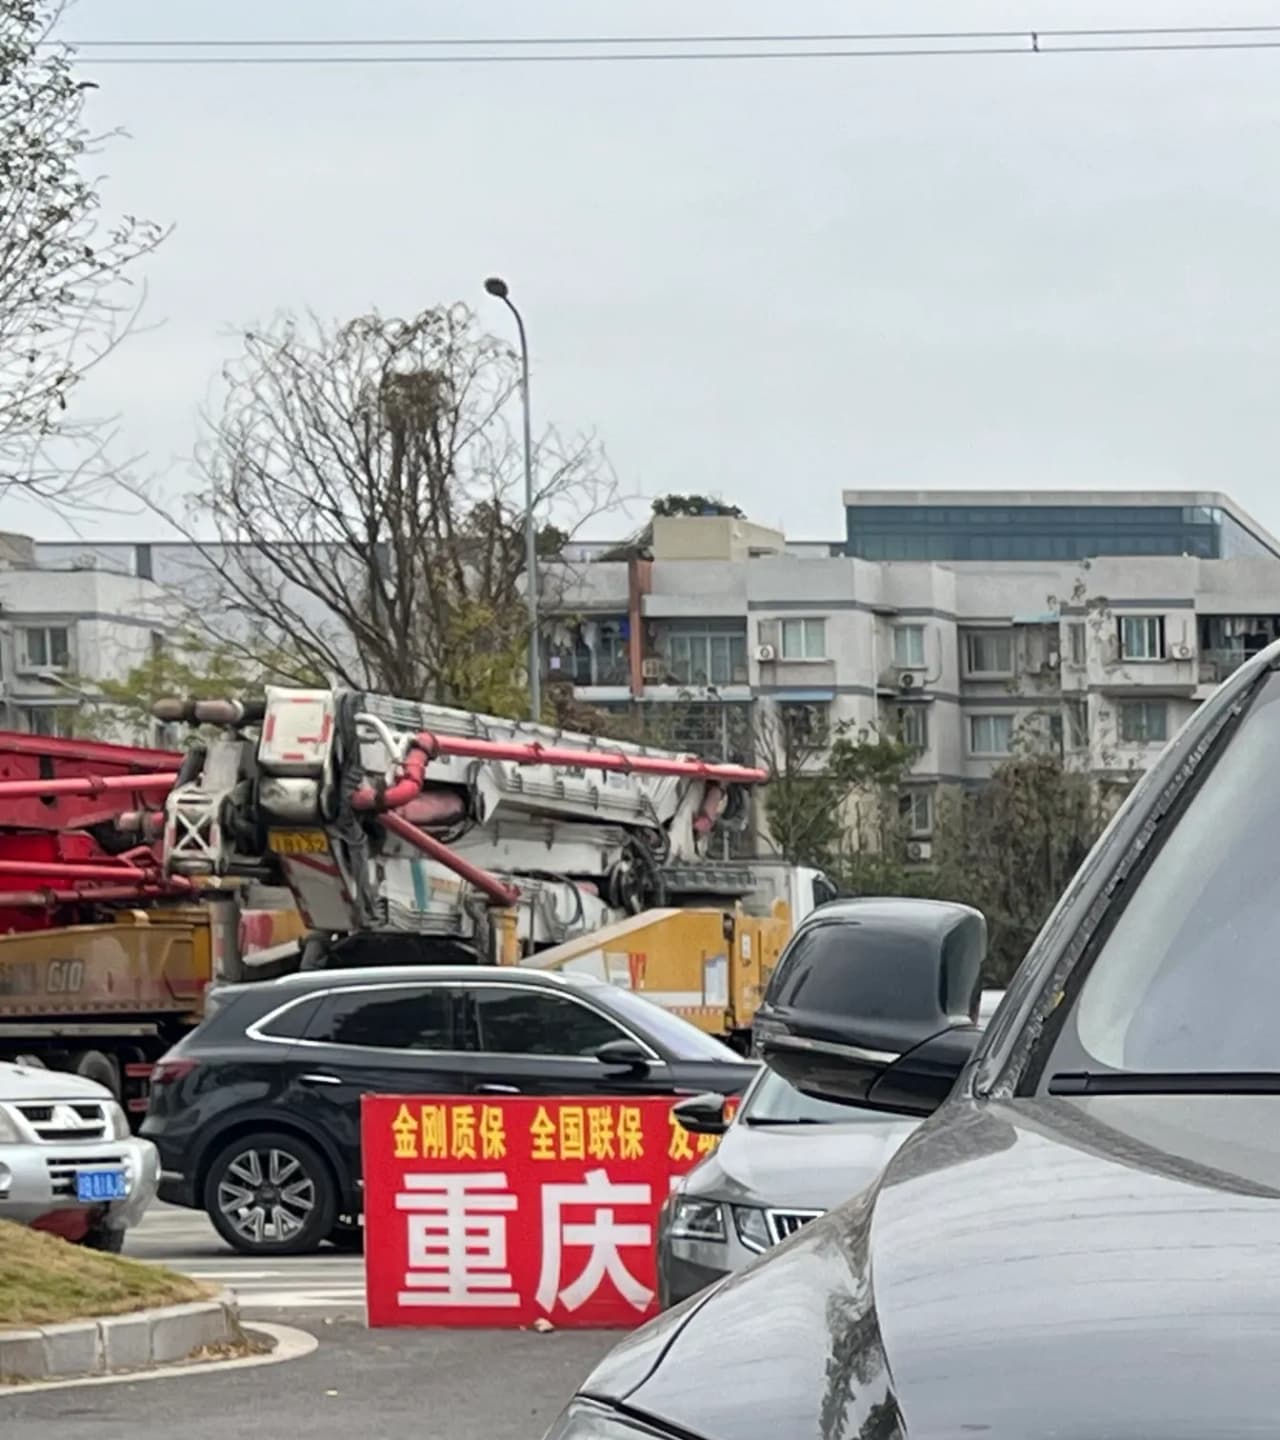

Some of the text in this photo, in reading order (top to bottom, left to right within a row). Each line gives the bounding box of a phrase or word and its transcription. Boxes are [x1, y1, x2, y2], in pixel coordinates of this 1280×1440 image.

[391, 1104, 507, 1159] 金刚质保
[530, 1106, 645, 1160] 全国联保
[395, 1168, 688, 1313] 重庆
